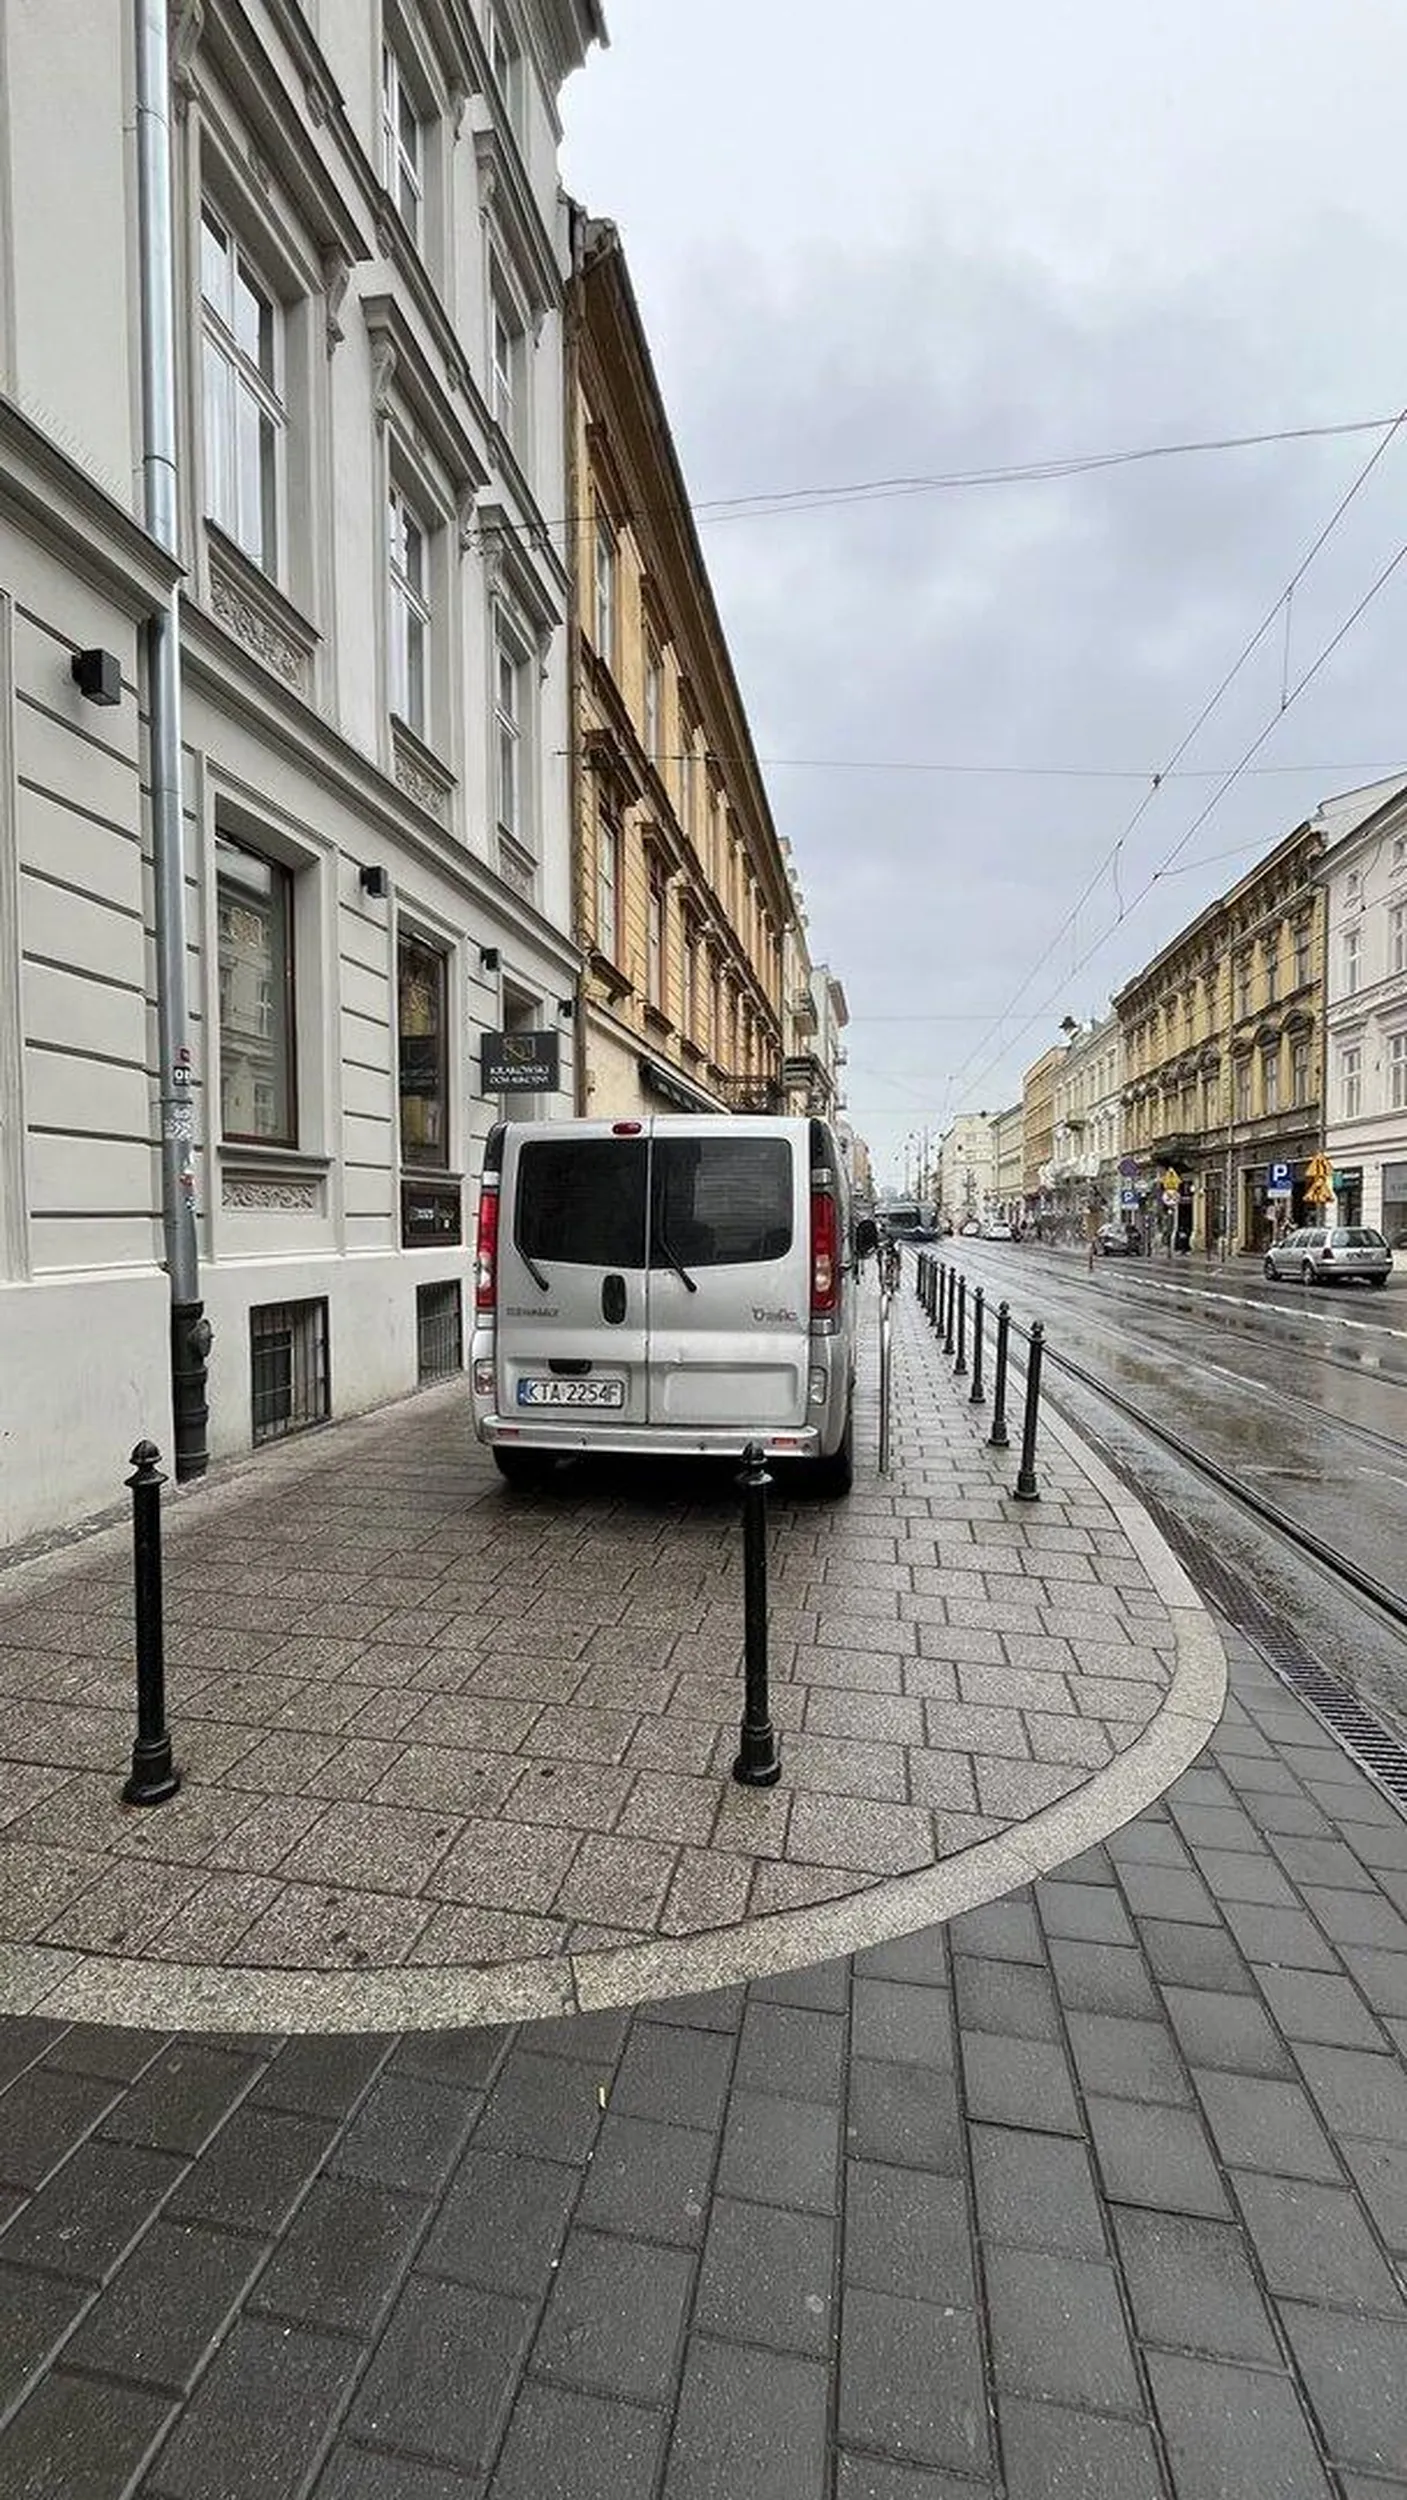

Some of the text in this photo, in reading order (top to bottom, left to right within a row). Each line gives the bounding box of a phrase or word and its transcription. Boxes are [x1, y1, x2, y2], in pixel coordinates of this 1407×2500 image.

[1273, 1164, 1288, 1181] P
[529, 1383, 618, 1402] KTA 2254F
